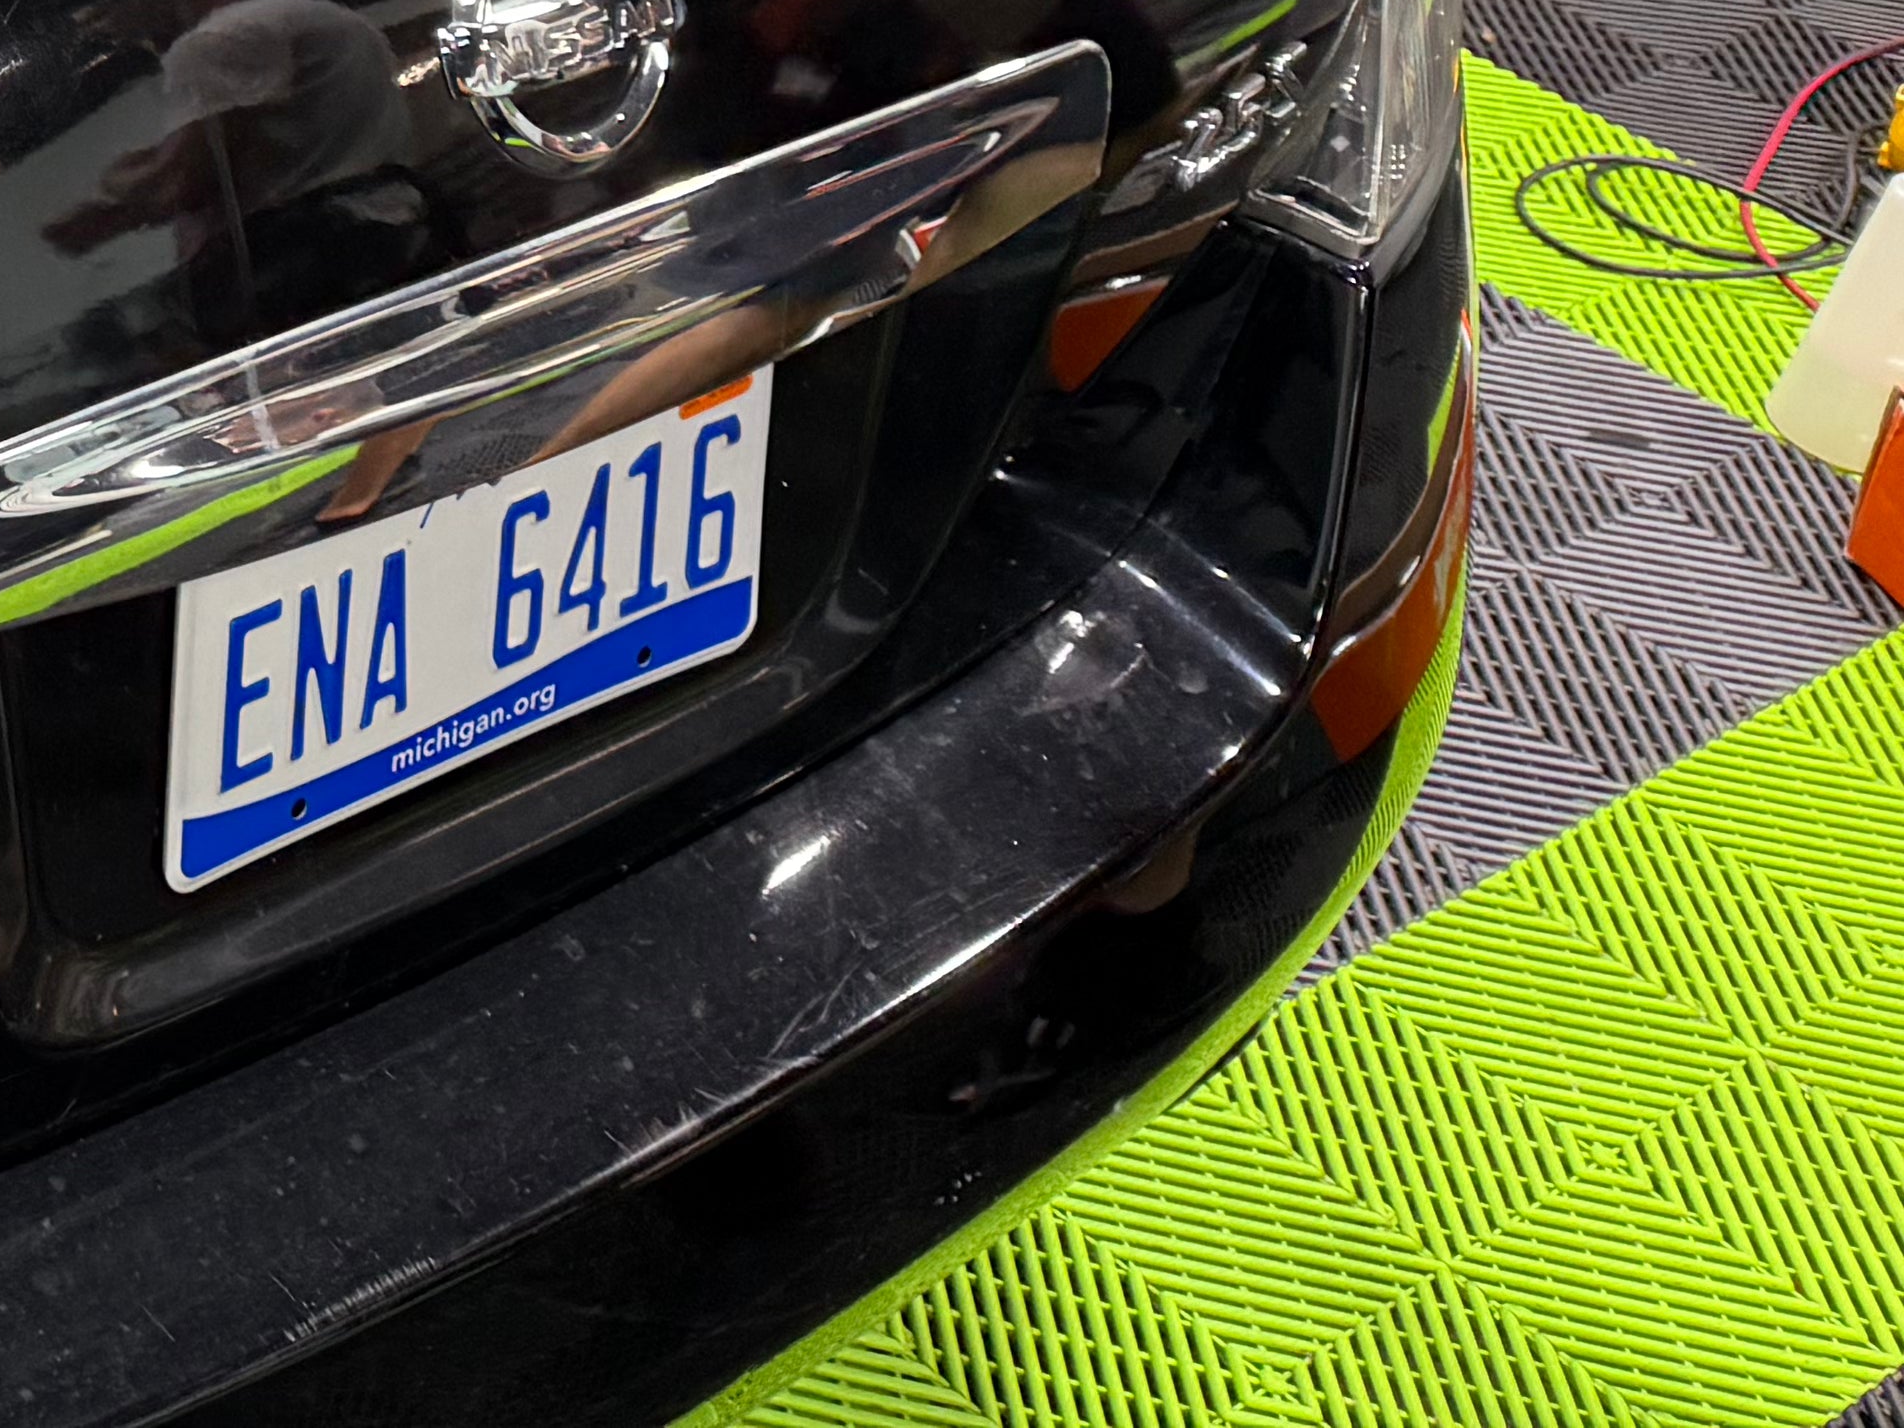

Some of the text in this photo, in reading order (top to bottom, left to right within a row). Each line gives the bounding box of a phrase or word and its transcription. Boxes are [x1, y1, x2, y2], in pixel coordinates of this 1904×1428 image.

[220, 413, 741, 794] ENA 6416
[391, 683, 556, 773] michigan.org
